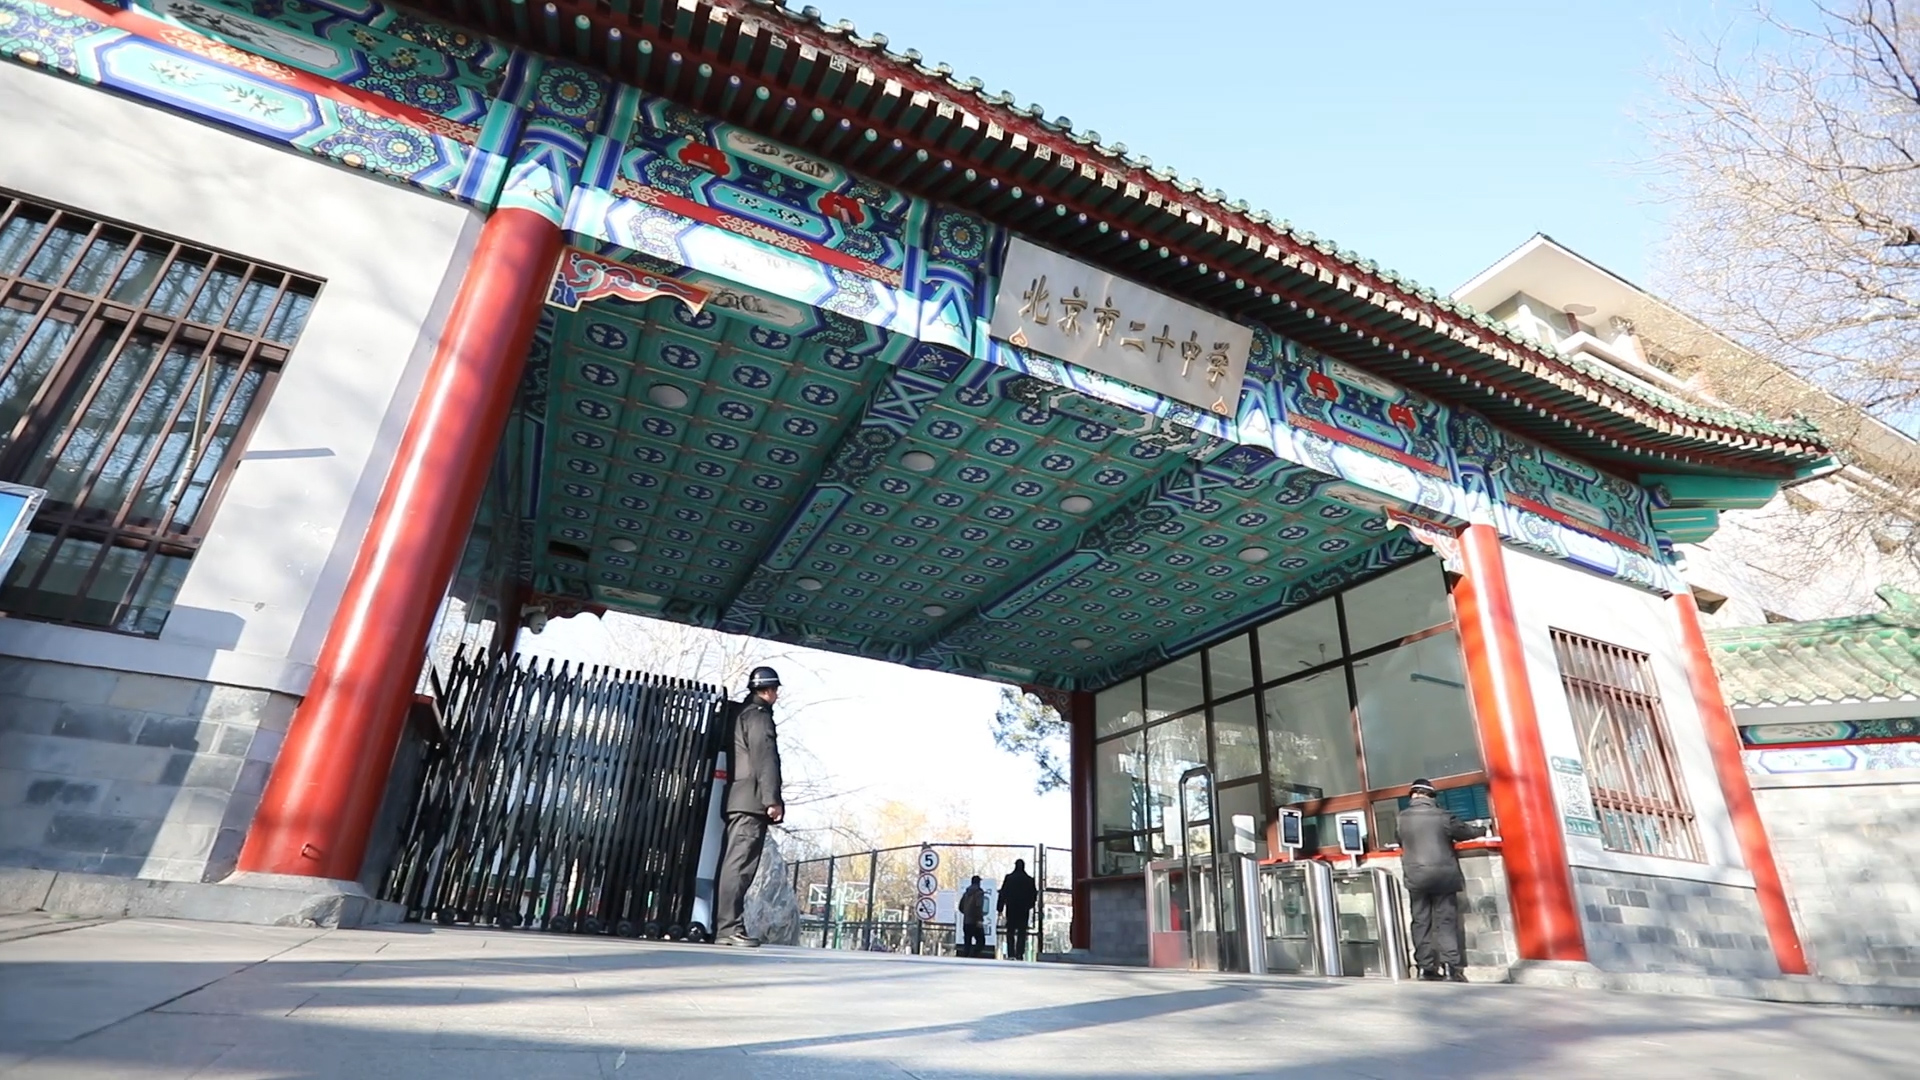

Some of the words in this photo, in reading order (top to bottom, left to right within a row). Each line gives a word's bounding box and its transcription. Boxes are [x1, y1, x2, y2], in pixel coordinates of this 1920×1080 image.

[1018, 275, 1229, 383] 北京市二十中学
[925, 854, 933, 867] 5
